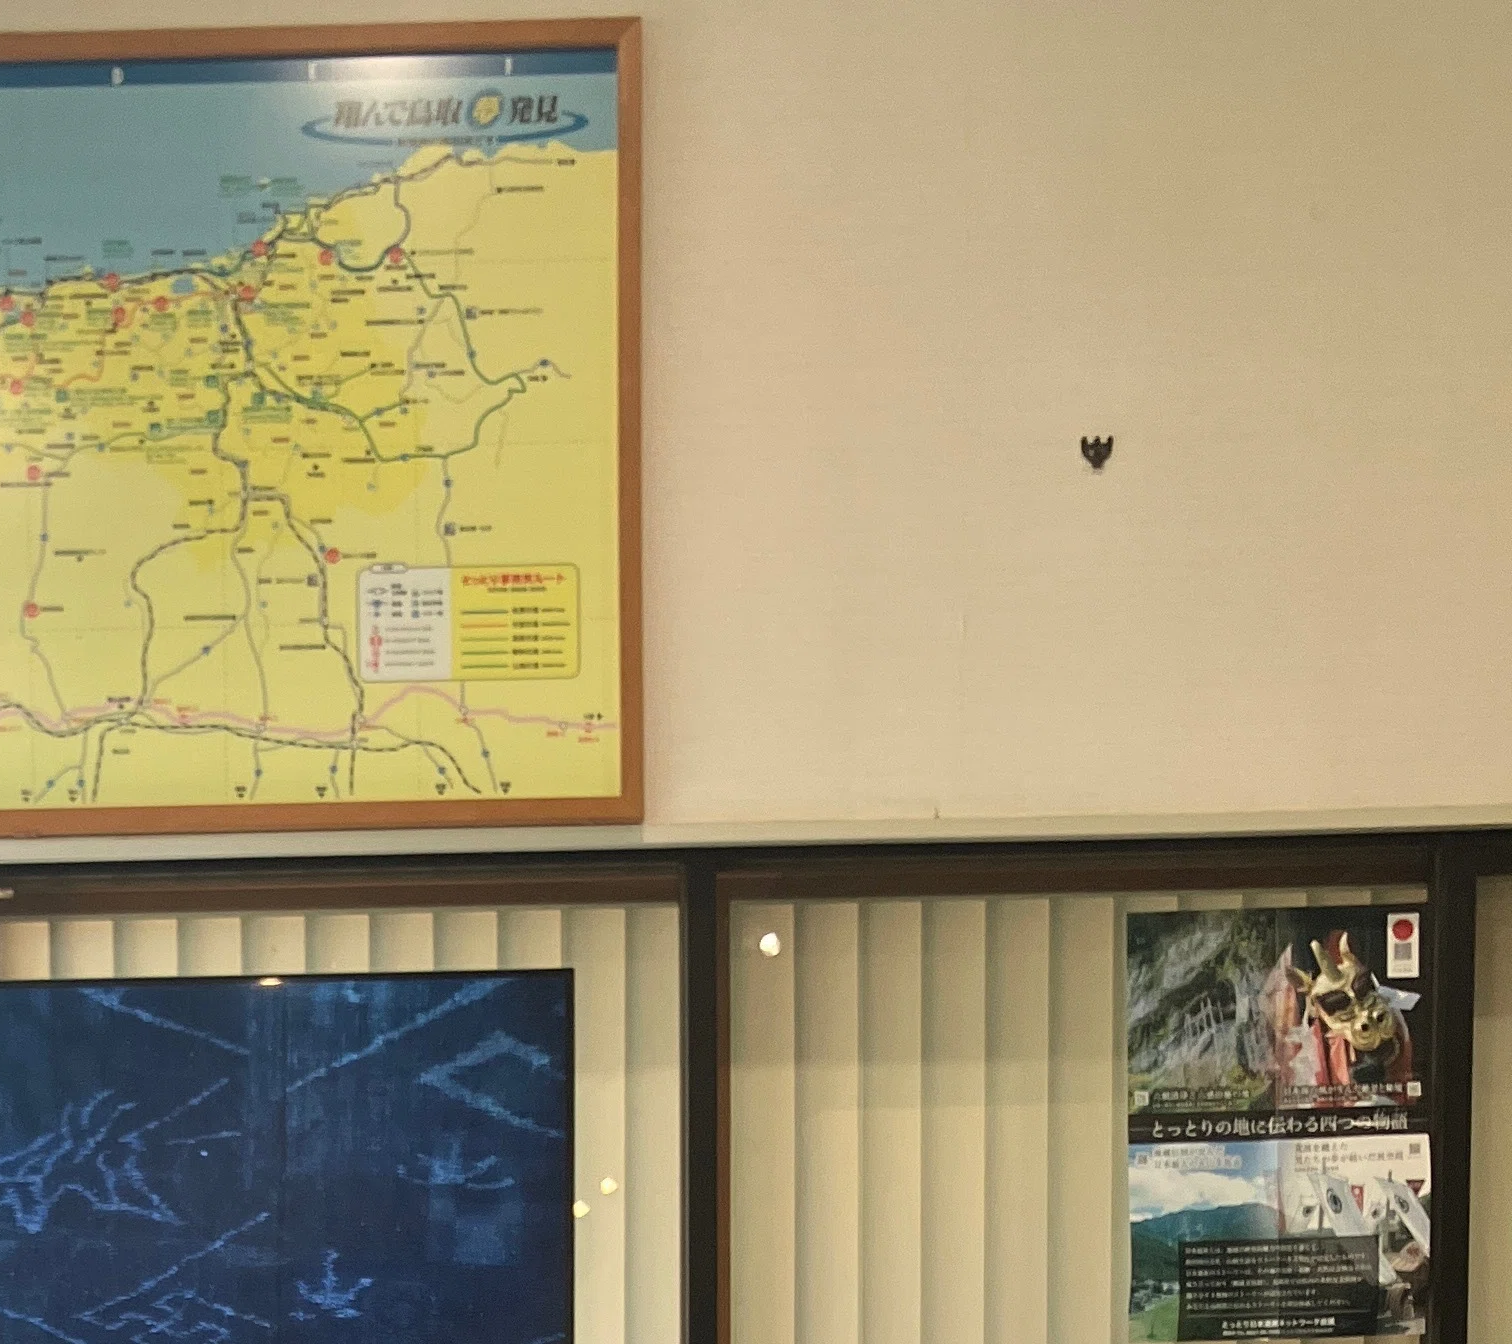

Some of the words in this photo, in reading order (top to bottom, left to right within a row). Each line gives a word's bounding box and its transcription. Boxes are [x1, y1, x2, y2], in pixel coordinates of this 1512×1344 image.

[1152, 1107, 1408, 1138] とっとりの地に伝わる四つの物語
